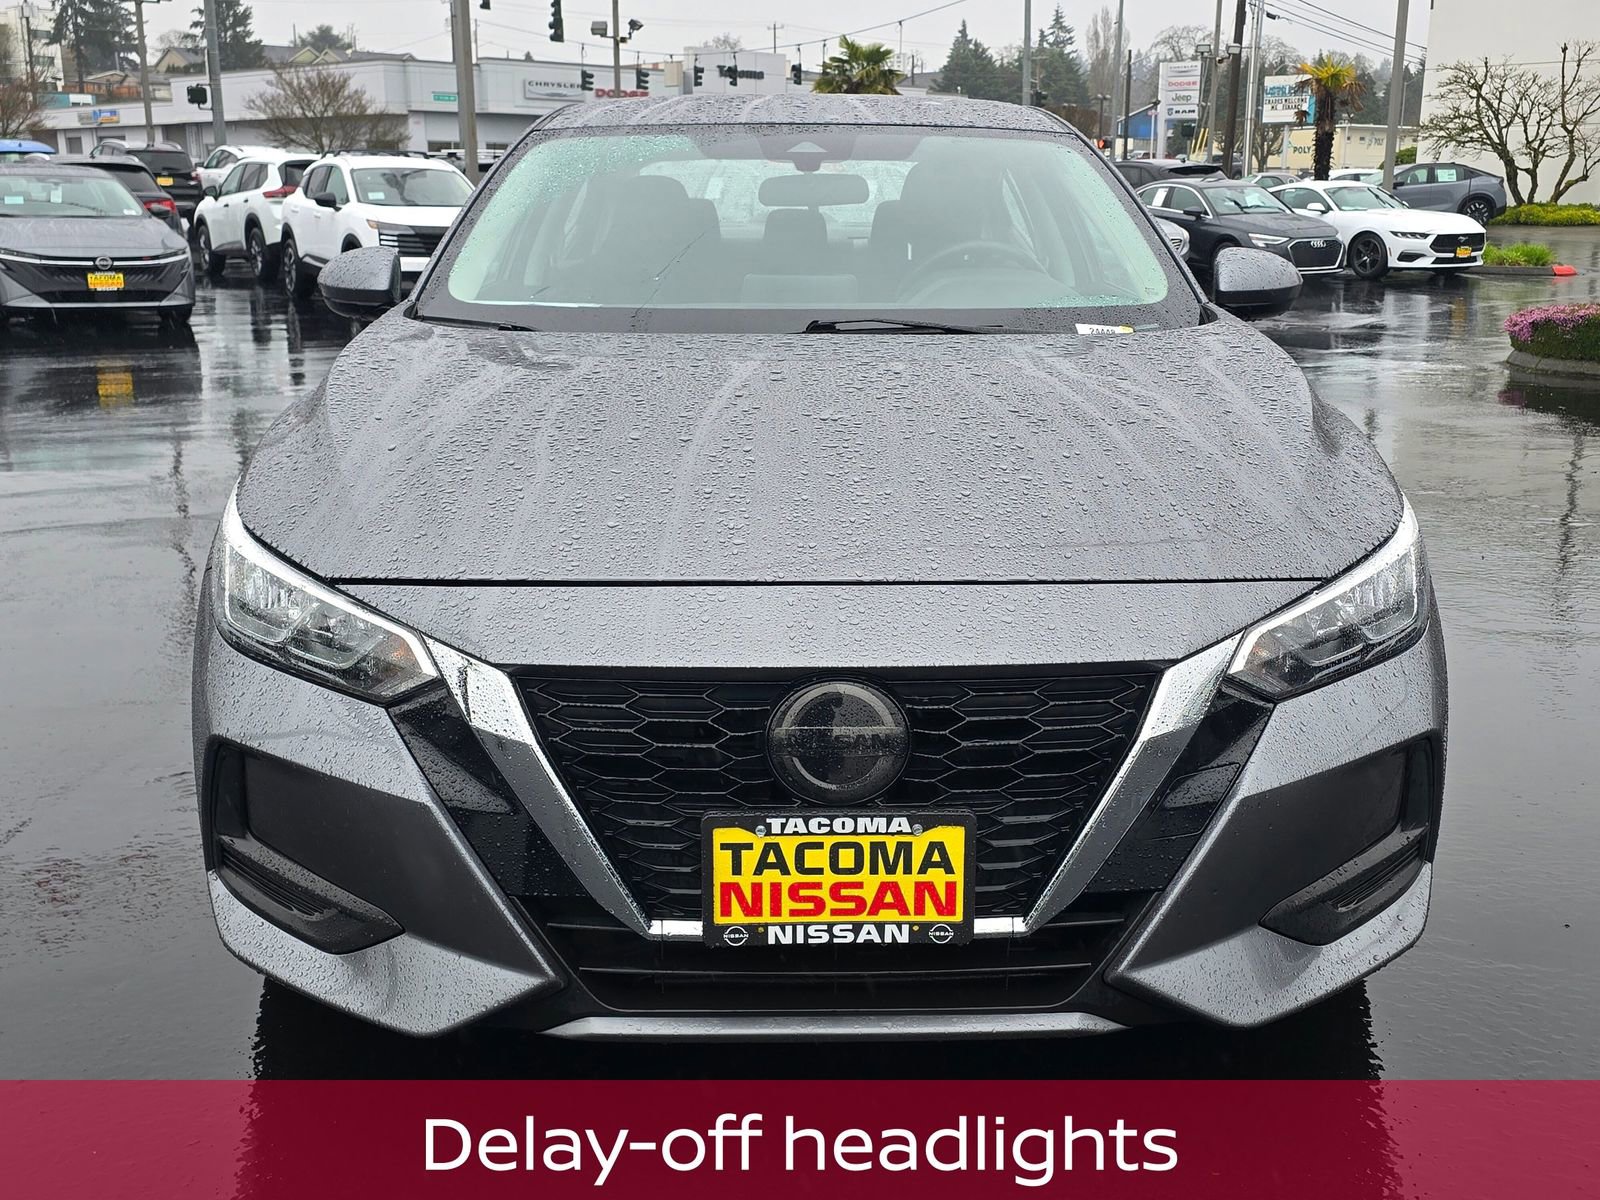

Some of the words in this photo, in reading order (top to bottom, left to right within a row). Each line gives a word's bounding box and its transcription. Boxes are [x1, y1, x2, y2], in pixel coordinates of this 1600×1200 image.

[717, 65, 765, 80] Taoma
[594, 88, 649, 98] DODGE
[1172, 93, 1192, 103] Jeep
[1293, 146, 1312, 154] POLY
[766, 817, 912, 834] TACOMA
[720, 841, 955, 876] TACOMA
[719, 881, 957, 917] NISSAN
[768, 924, 910, 944] NISSAN
